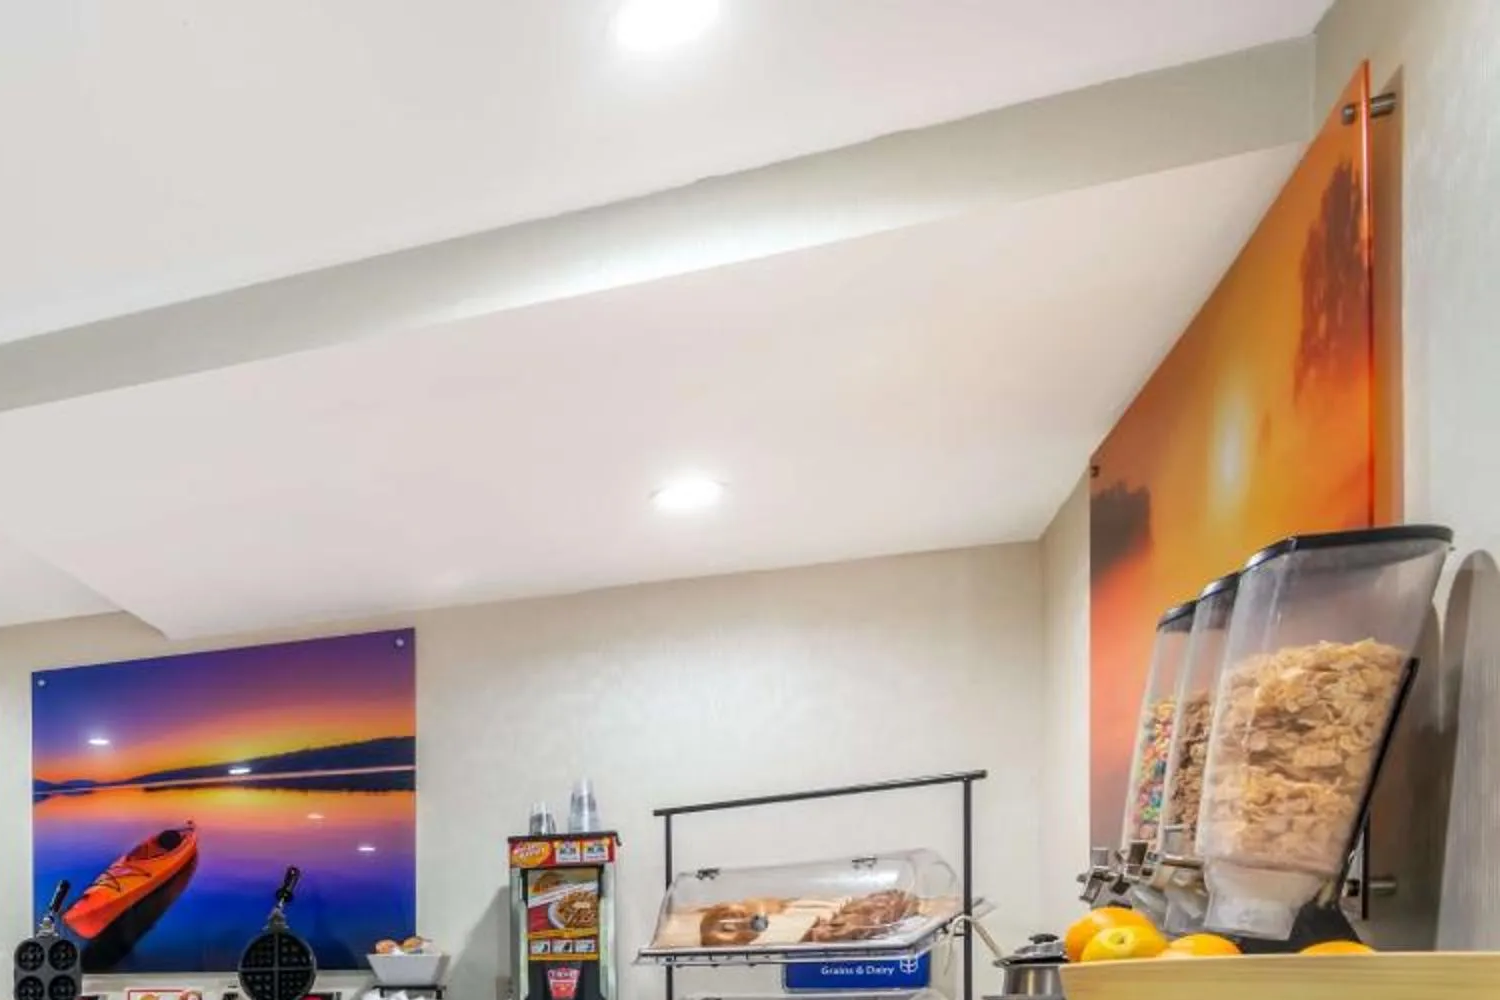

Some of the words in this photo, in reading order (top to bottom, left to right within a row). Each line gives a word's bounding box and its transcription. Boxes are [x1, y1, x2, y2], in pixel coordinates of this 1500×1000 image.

[821, 966, 854, 975] Grains
[856, 965, 864, 975] &
[866, 965, 895, 977] Dairy
